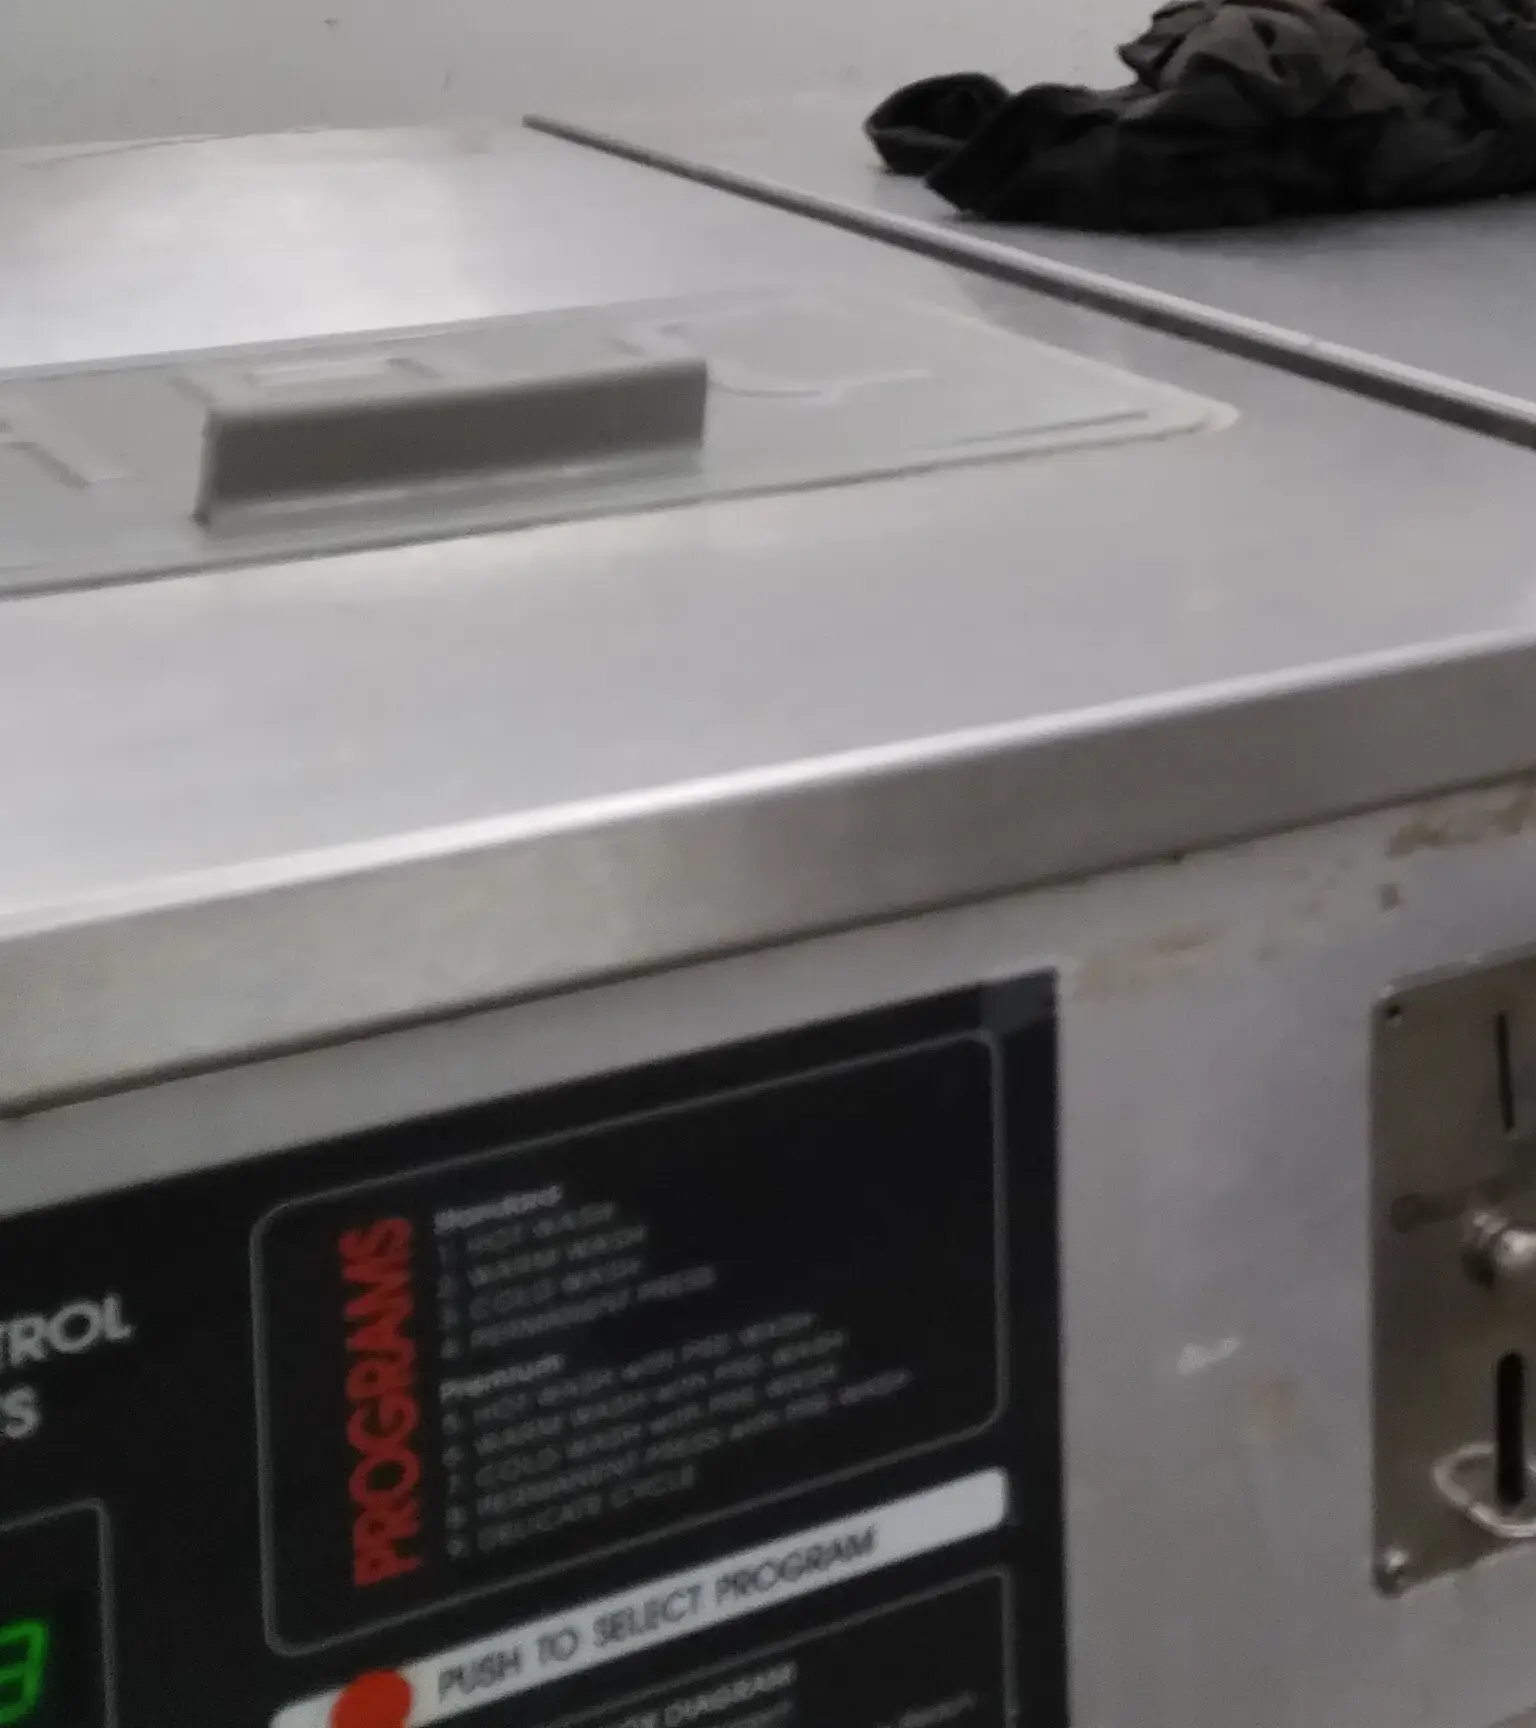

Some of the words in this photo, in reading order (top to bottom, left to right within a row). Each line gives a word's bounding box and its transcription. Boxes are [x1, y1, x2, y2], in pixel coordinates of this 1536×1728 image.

[338, 1216, 425, 1588] PROGRAMS
[437, 1647, 525, 1703] PUSH
[533, 1628, 581, 1669] TO
[592, 1583, 702, 1656] SELECT
[710, 1524, 880, 1609] PROGRAM
